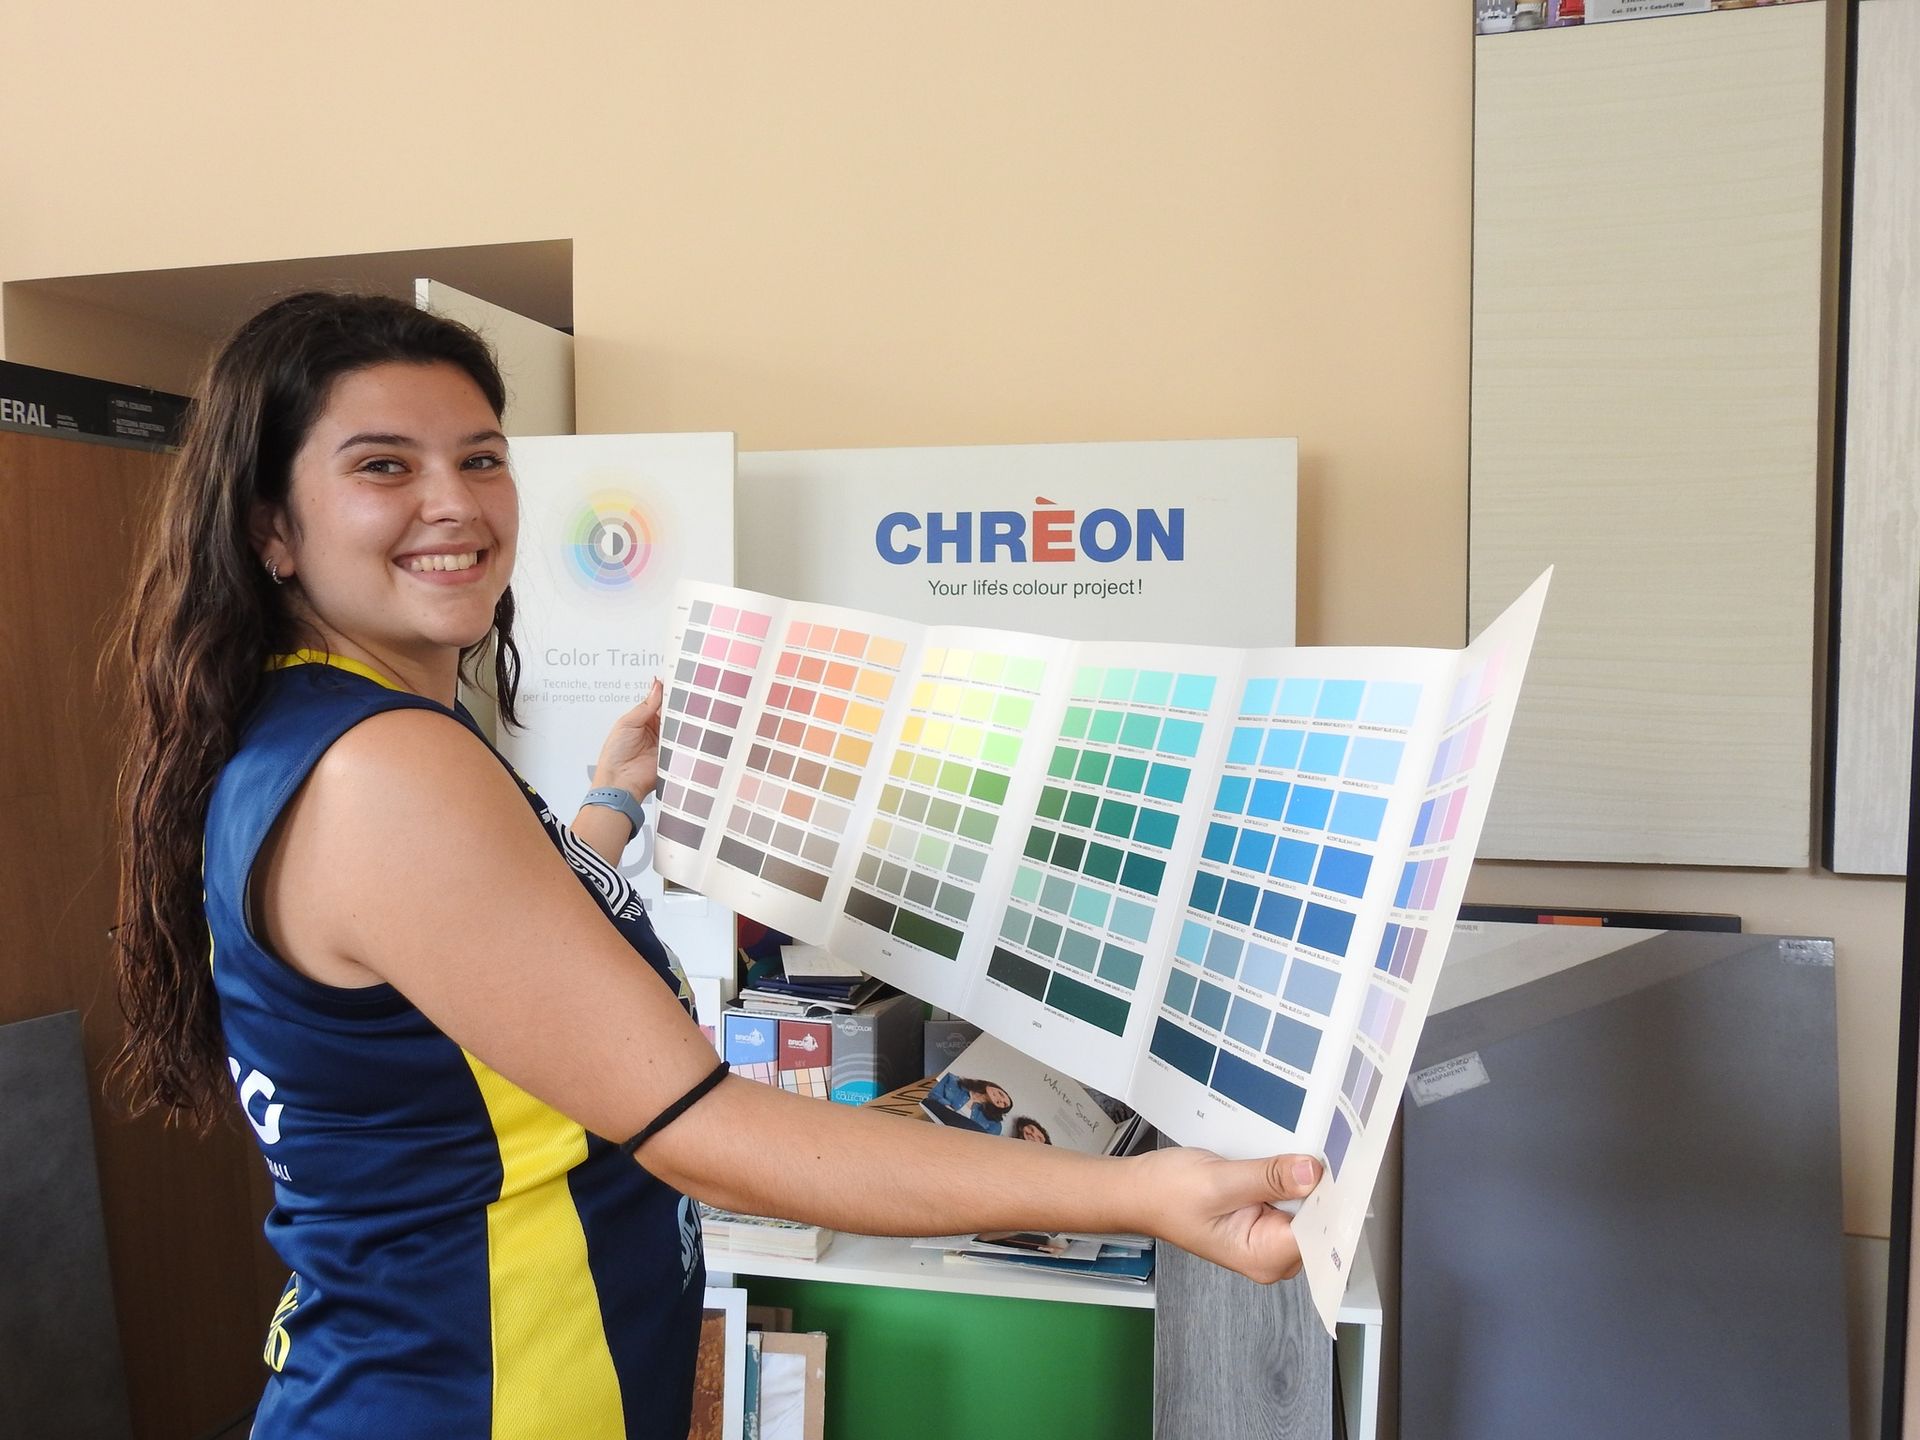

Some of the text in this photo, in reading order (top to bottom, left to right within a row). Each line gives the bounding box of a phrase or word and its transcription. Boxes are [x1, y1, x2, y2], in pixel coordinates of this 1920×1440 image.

[875, 496, 1185, 565] CHRÈON
[928, 579, 968, 596] Your
[1012, 579, 1068, 596] colour
[545, 648, 600, 667] Color
[594, 679, 621, 690] trend
[624, 681, 632, 690] e
[523, 693, 539, 704] per
[543, 691, 549, 703] il
[552, 692, 596, 705] progetto
[599, 692, 631, 703] colore
